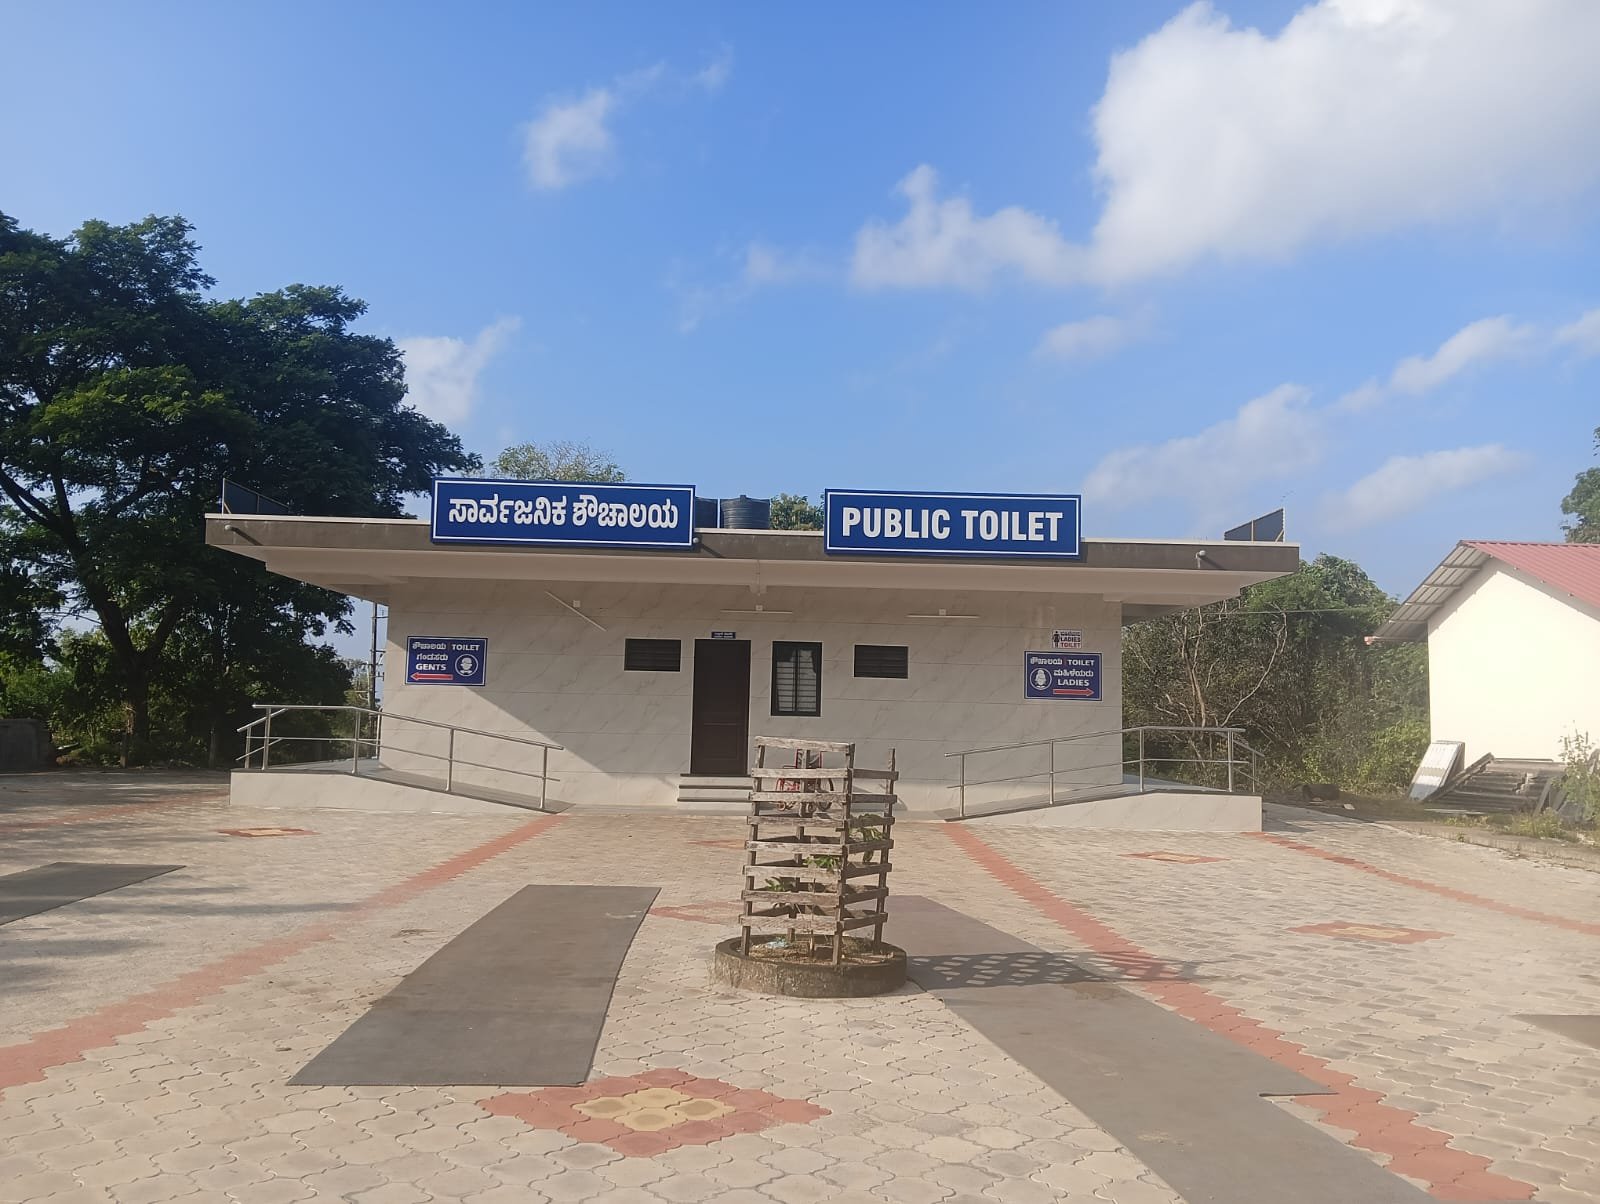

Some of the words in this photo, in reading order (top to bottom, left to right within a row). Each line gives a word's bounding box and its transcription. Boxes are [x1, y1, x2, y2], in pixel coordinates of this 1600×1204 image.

[448, 493, 568, 526] ಸಾರ್ವಜನಿಕ
[572, 494, 679, 529] ಶೌಚಾಲಯ
[842, 507, 951, 540] PUBLIC
[961, 510, 1063, 542] TOILET
[451, 643, 481, 651] TOILET
[415, 663, 447, 671] GENTS
[1057, 679, 1090, 687] LADIES
